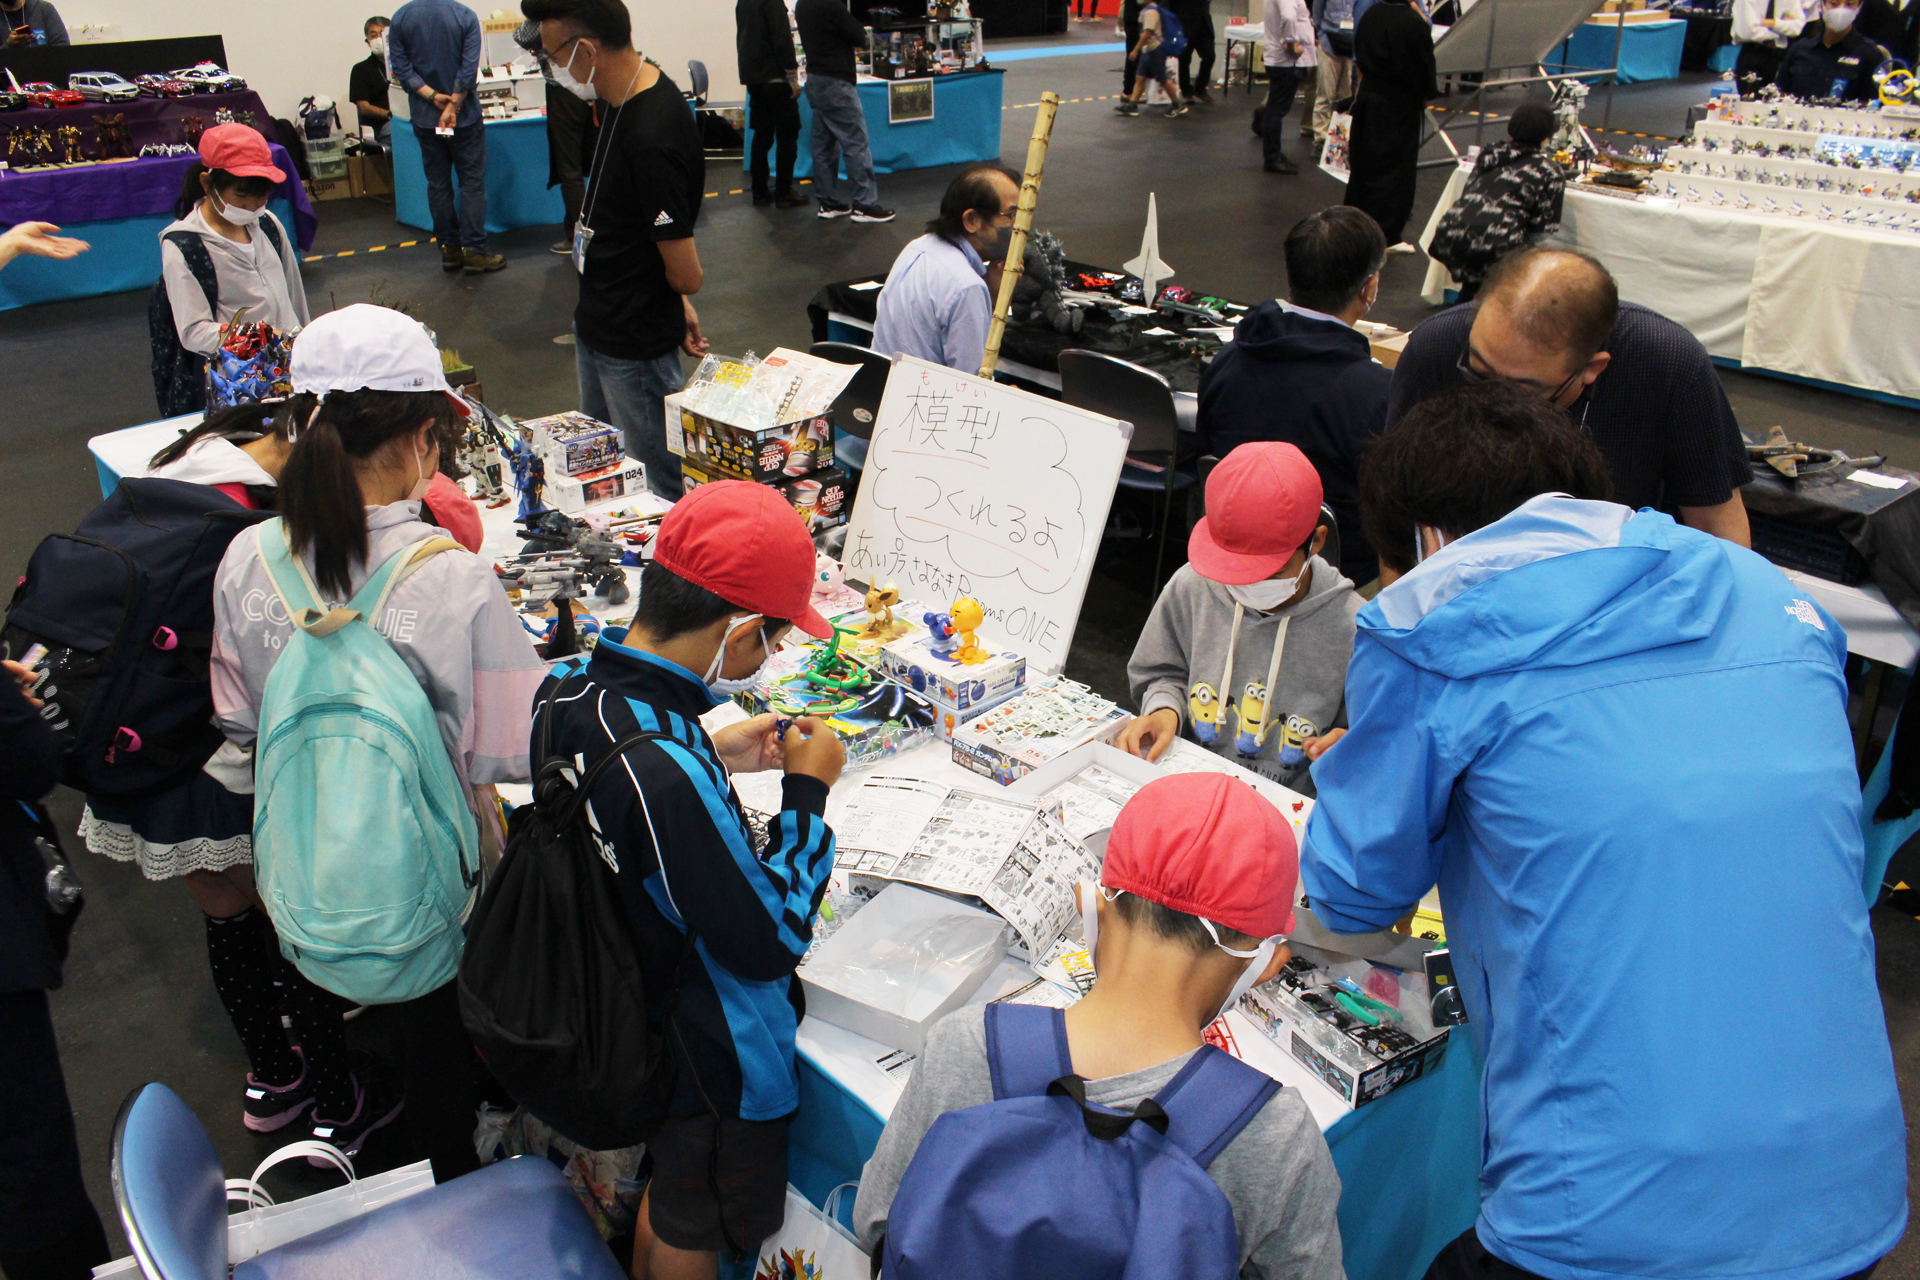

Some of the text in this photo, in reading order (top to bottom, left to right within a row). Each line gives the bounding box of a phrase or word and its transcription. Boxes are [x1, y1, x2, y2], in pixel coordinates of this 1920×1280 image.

[653, 217, 674, 227] adidas
[899, 385, 1000, 460] 模型
[625, 467, 643, 480] 024
[914, 475, 1063, 560] つくれるよ
[263, 629, 282, 650] to
[952, 740, 976, 755] RX-78-2
[974, 749, 995, 763] ガンダム
